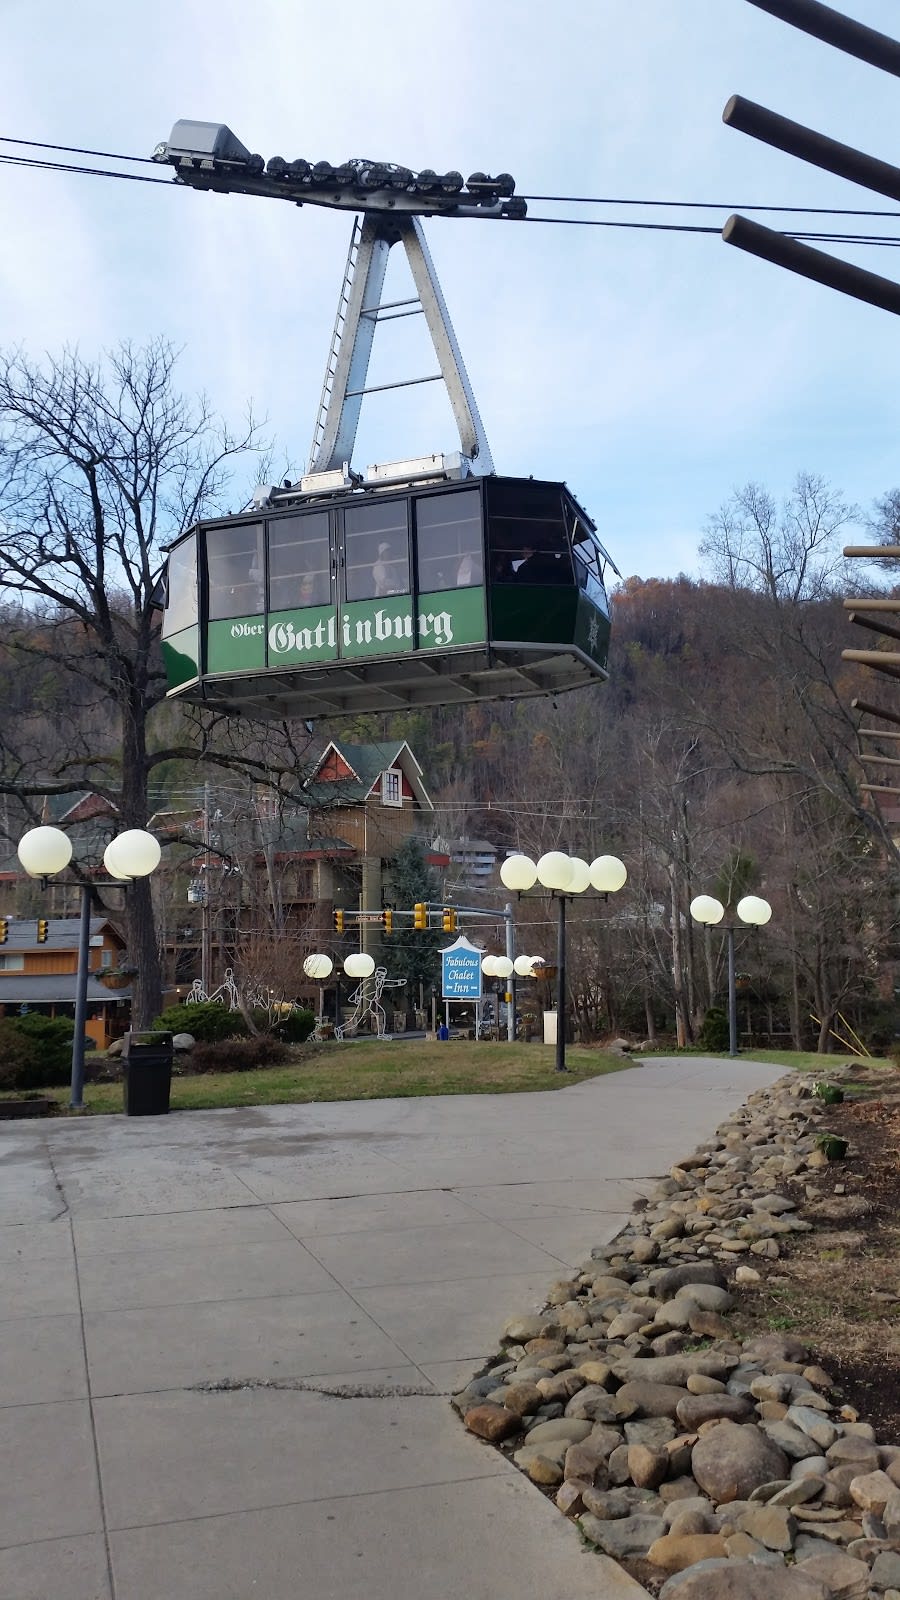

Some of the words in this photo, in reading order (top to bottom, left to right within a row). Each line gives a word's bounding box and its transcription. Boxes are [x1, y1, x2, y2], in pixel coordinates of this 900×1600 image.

[230, 623, 265, 638] Ober
[268, 608, 453, 653] Gatlinburg
[445, 956, 478, 967] Fabulous
[448, 969, 474, 980] Chalet
[453, 982, 470, 993] Inn
